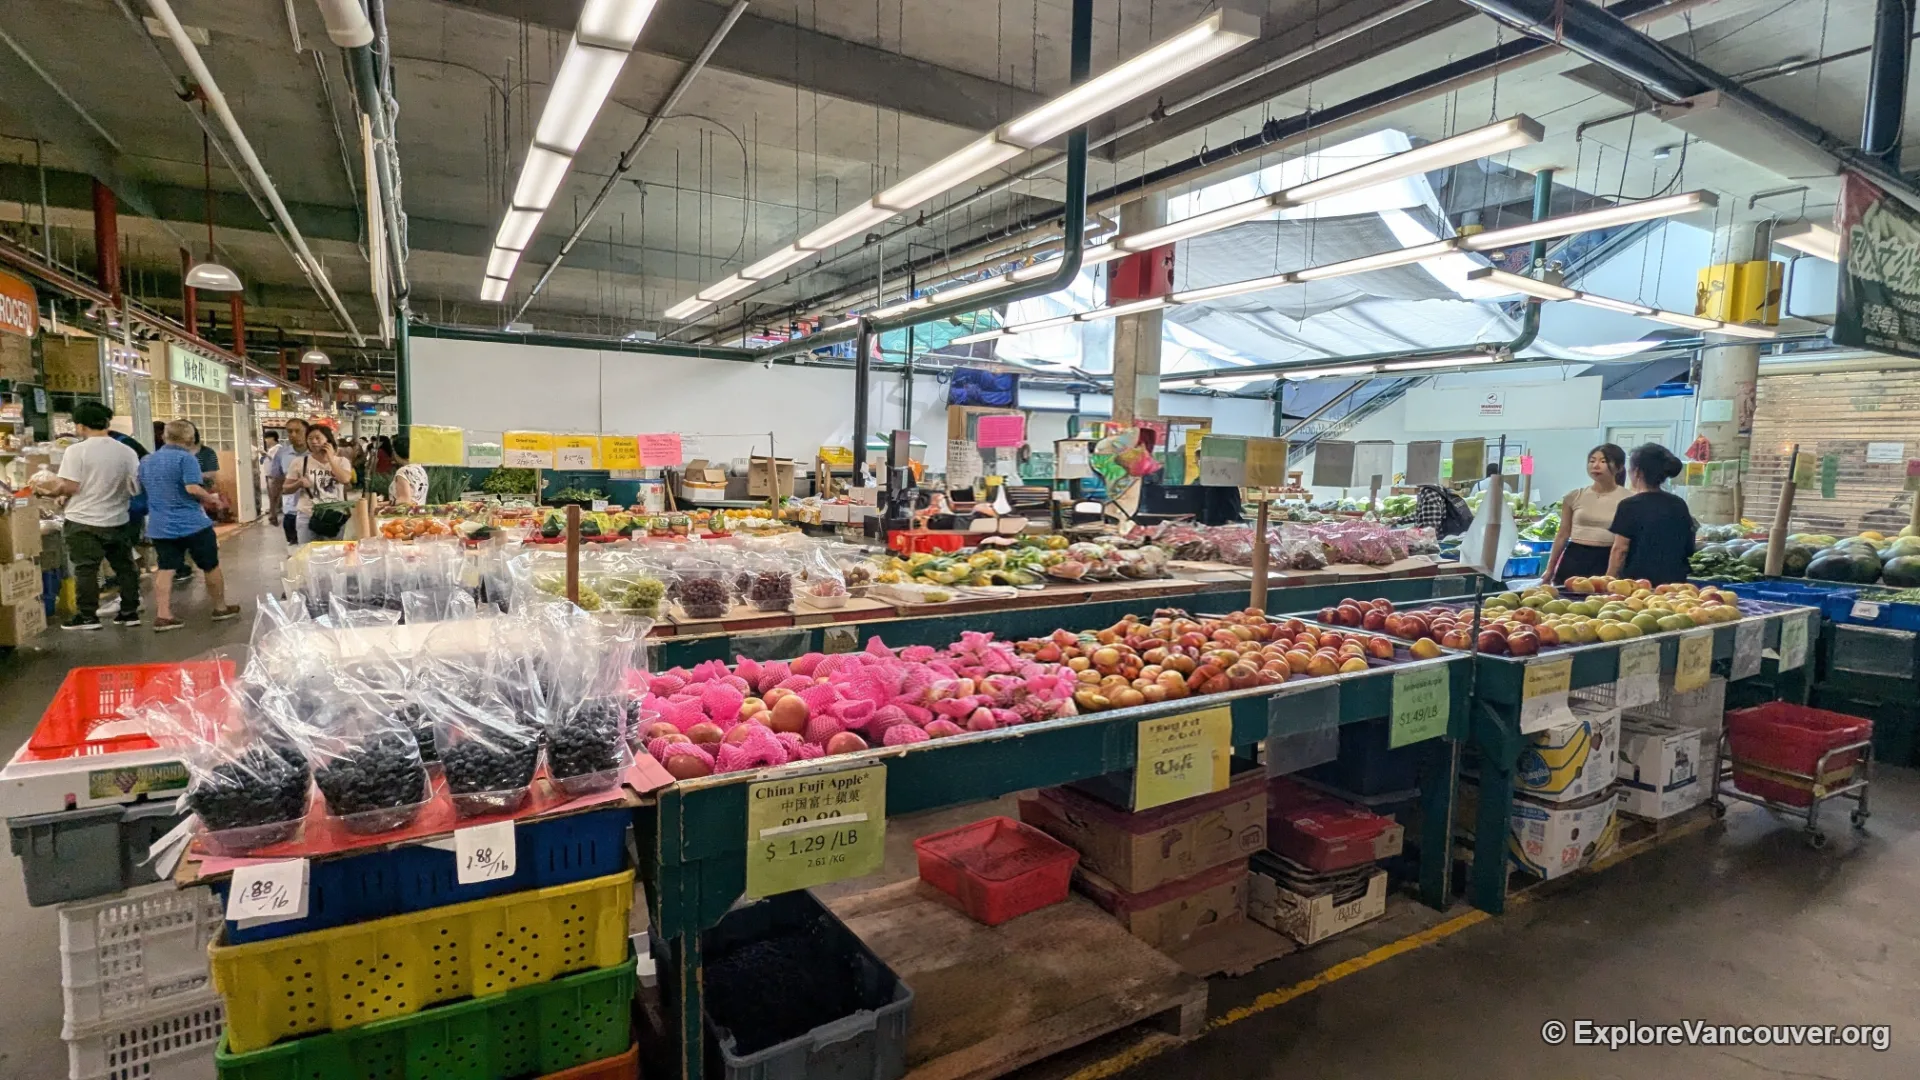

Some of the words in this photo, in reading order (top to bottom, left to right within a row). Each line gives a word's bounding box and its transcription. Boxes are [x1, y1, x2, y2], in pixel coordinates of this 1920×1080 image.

[756, 785, 794, 799] China
[799, 780, 824, 793] Fuji
[766, 842, 776, 862] $
[789, 835, 825, 856] 1.29
[830, 829, 858, 851] /LB
[829, 854, 845, 866] /KG
